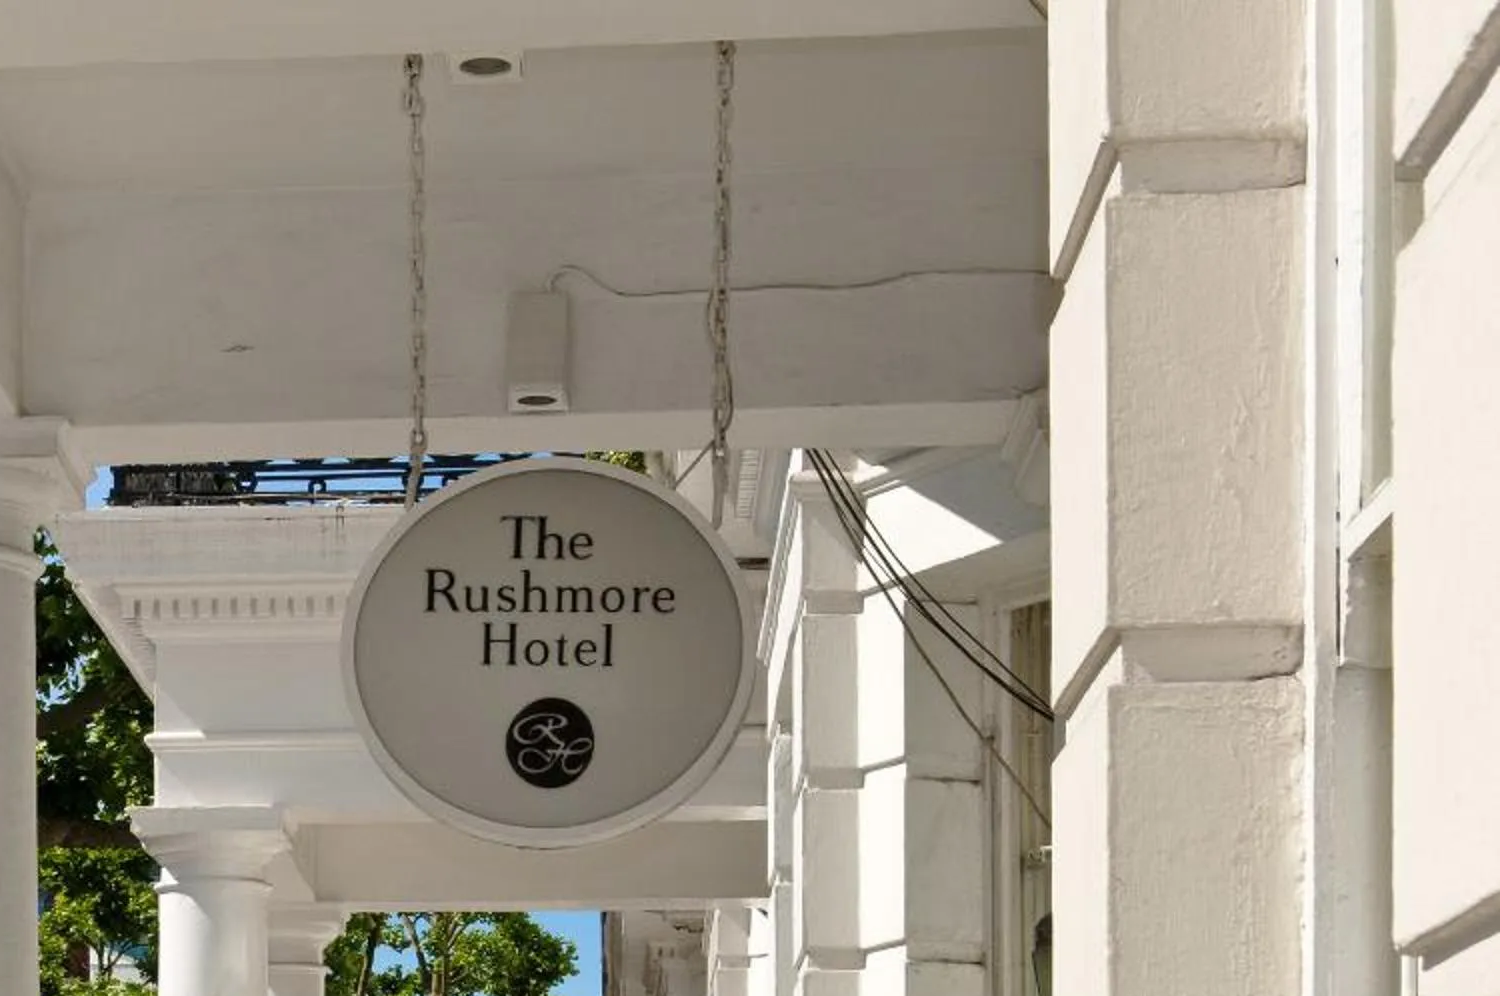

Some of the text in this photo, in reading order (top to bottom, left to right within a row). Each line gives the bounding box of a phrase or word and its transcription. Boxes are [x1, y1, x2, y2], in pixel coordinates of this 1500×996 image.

[501, 516, 594, 561] The
[424, 569, 676, 614] Rushmore
[481, 622, 614, 667] Hotel
